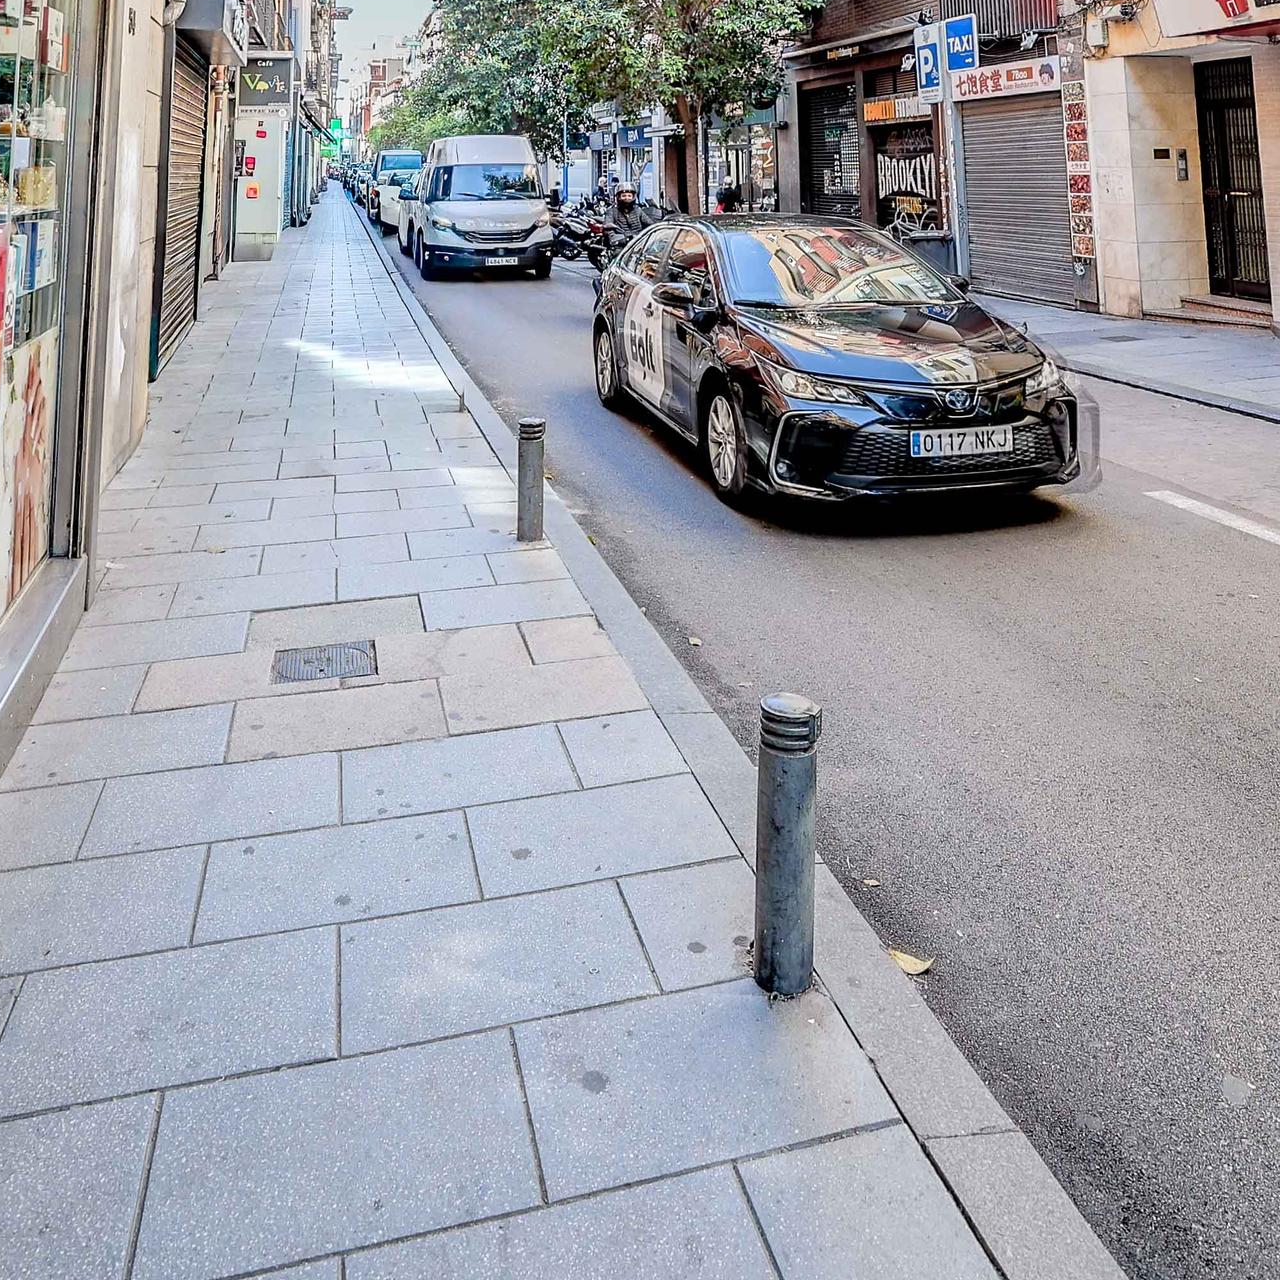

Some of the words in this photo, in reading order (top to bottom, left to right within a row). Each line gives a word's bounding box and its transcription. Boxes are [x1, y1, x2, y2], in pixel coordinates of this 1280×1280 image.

[947, 34, 973, 54] TAXI
[919, 48, 934, 86] P
[956, 69, 1003, 97] 七饱食堂
[630, 319, 656, 378] Bolt
[923, 432, 967, 453] 0117
[974, 428, 1007, 450] NKJ
